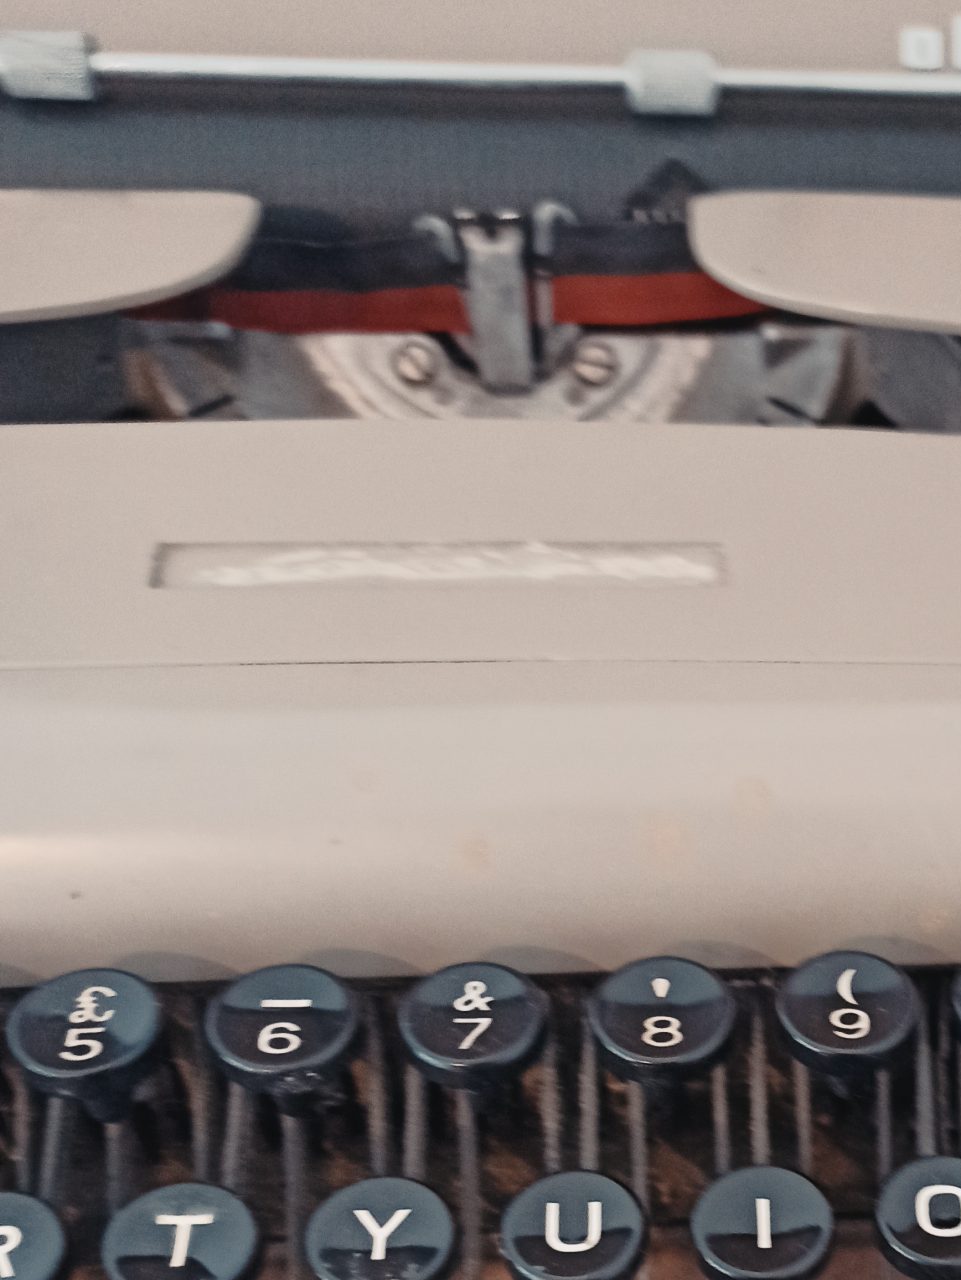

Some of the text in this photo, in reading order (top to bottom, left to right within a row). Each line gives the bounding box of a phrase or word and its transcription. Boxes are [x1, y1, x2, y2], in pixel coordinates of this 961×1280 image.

[68, 986, 117, 1023] £
[453, 980, 495, 1012] &
[836, 968, 858, 1005] (
[257, 1021, 302, 1055] 6
[452, 1017, 492, 1050] 7
[641, 1015, 684, 1047] 8
[829, 1008, 871, 1039] 9
[58, 1026, 106, 1061] 5
[155, 1212, 215, 1268] T
[352, 1208, 412, 1261] Y
[545, 1201, 602, 1253] U
[755, 1198, 772, 1249] I
